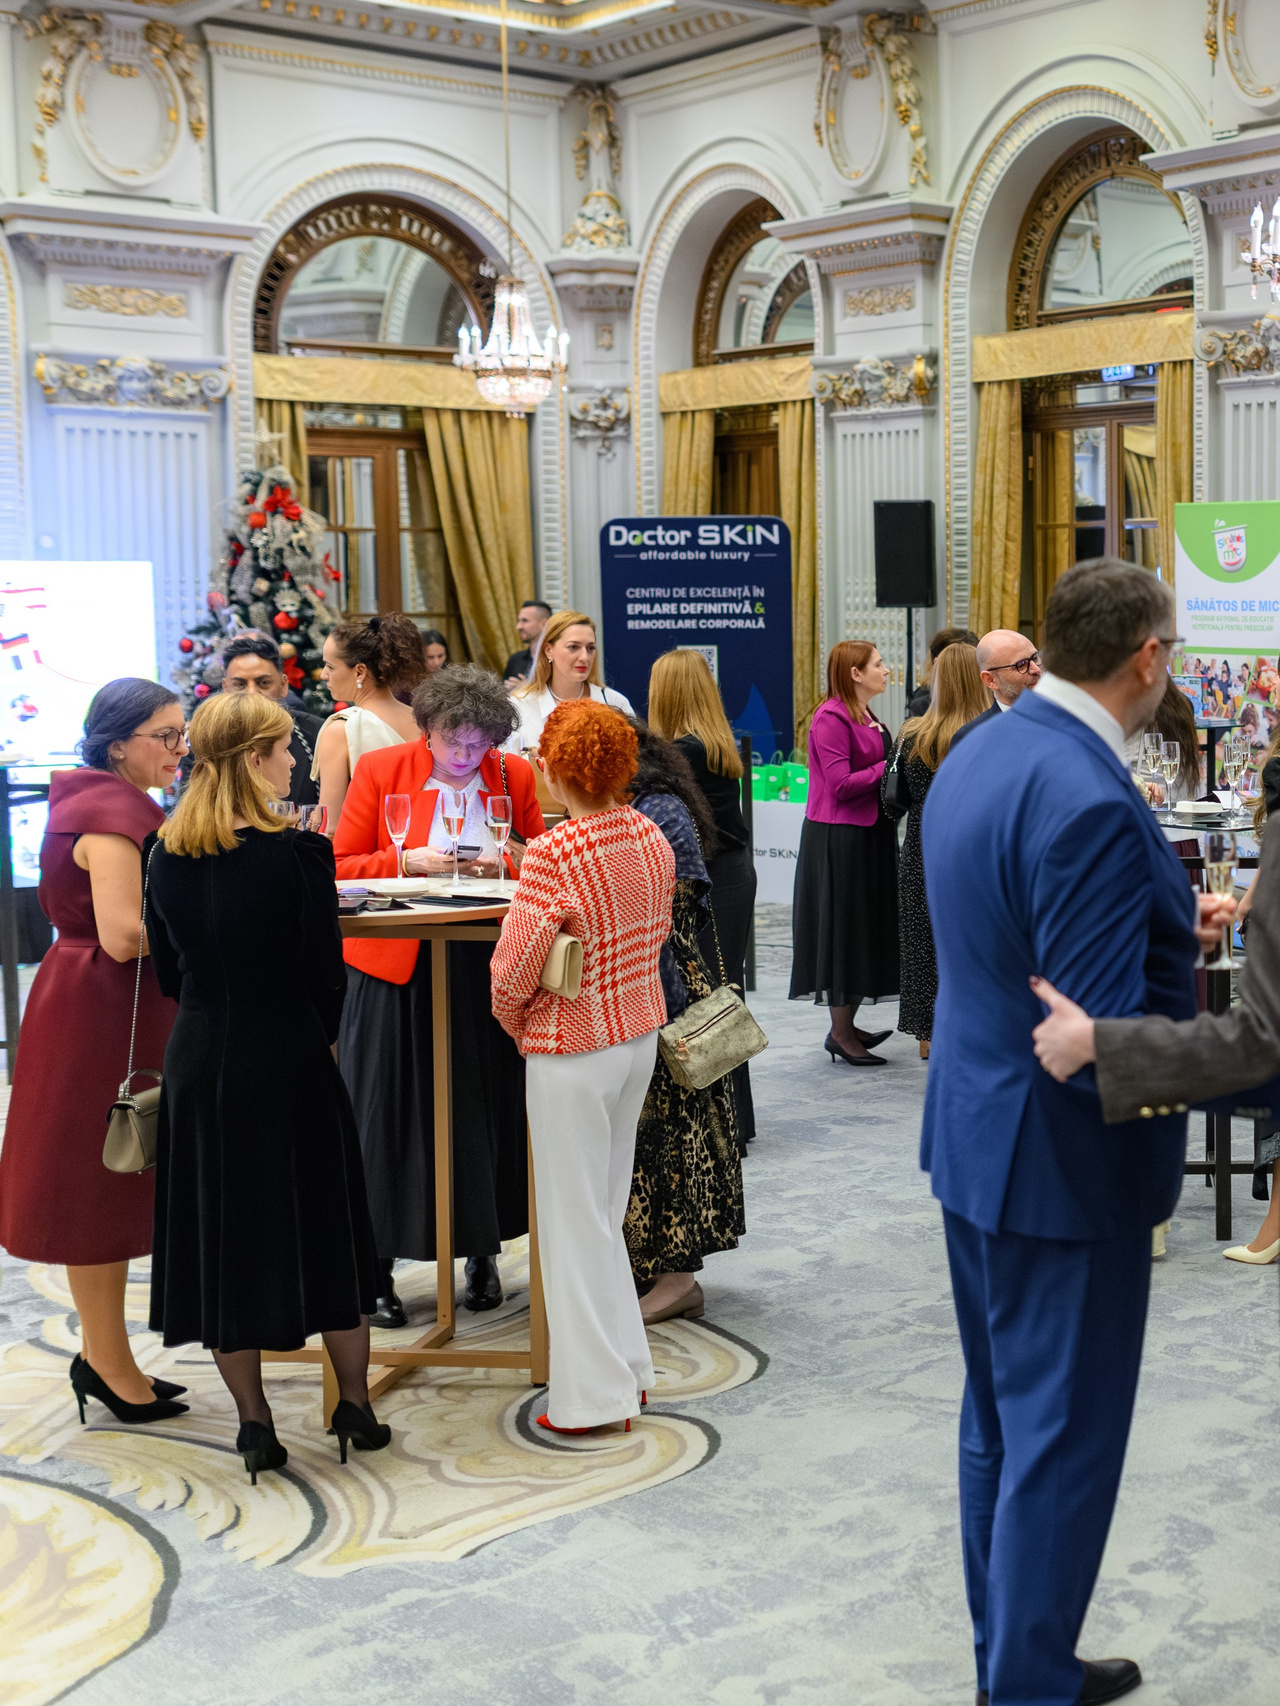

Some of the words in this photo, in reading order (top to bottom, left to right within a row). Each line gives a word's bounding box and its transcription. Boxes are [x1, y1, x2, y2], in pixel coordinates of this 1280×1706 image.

[609, 525, 691, 545] Doctor
[640, 550, 706, 560] affordable
[710, 550, 750, 562] luxury
[626, 588, 670, 598] CENTRU
[672, 588, 687, 598] DE
[753, 585, 765, 598] ÎN
[627, 603, 677, 615] EPILARE
[680, 600, 752, 614] DEFINITIVĂ
[754, 602, 765, 614] &
[1187, 597, 1238, 612] SĂNĂTOS
[1241, 600, 1256, 612] DE
[1259, 601, 1280, 612] MIC
[627, 619, 697, 629] REMODELARE
[699, 617, 765, 629] CORPORALĂ
